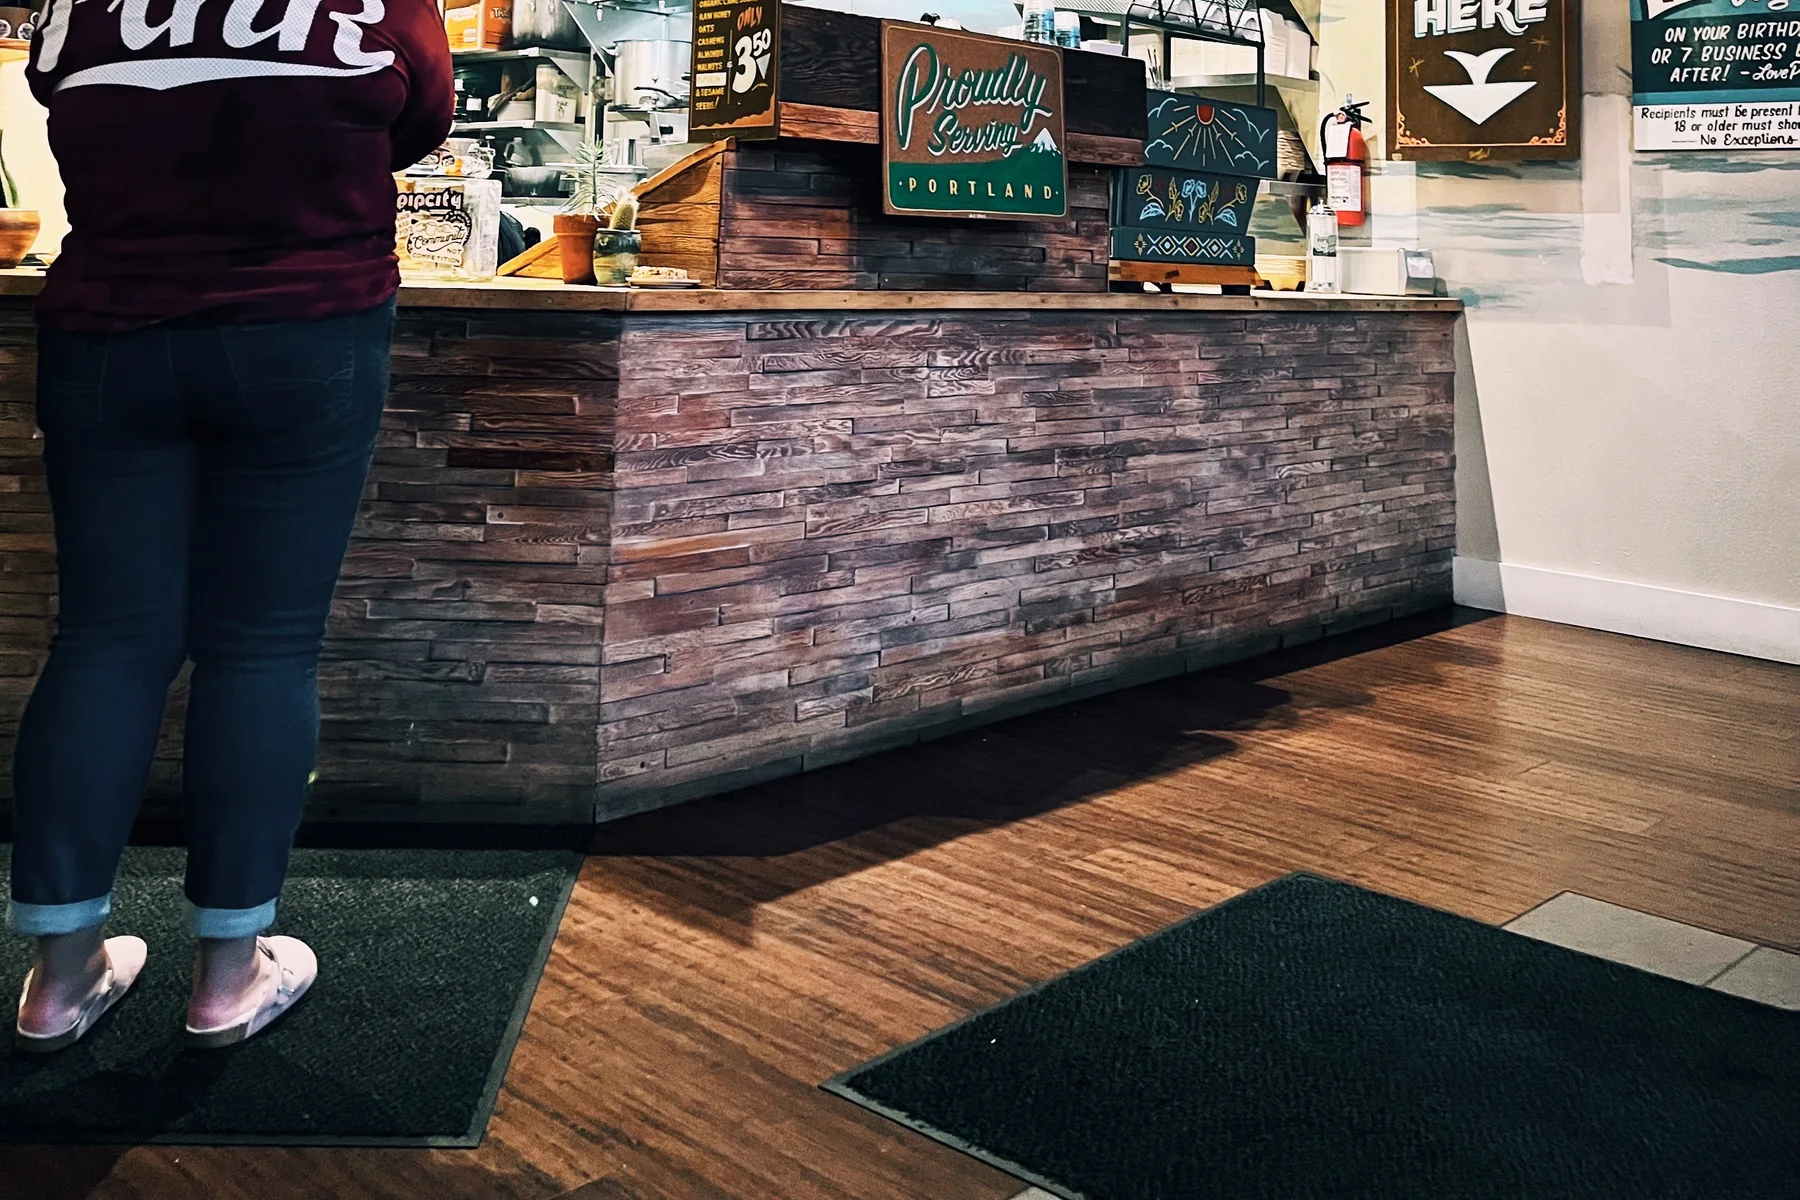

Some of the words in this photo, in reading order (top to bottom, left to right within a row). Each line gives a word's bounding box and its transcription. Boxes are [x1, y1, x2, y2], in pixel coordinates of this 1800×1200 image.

[699, 12, 712, 21] RAW
[737, 6, 763, 31] ONLY
[698, 24, 714, 33] OATS
[1665, 27, 1686, 43] ON
[1693, 25, 1731, 41] YOUR
[1737, 20, 1800, 39] BIRTHD
[697, 36, 725, 46] CASHEWS
[1651, 48, 1672, 65] OR
[1680, 47, 1693, 63] 7
[1701, 43, 1787, 62] BUSINESS
[1670, 64, 1730, 83] AFTER!
[701, 87, 725, 96] SESAME
[896, 43, 1052, 150] Proudly
[1641, 107, 1696, 121] Recipients
[1701, 106, 1729, 118] must
[1734, 105, 1748, 118] be
[1751, 104, 1793, 120] present
[928, 110, 1022, 157] Serving
[1674, 120, 1686, 132] 18
[1691, 122, 1703, 132] or
[1707, 120, 1738, 132] older
[1742, 120, 1771, 131] must
[1700, 135, 1717, 146] No
[1724, 132, 1794, 147] Exceptions
[909, 177, 1052, 199] PORTLAND
[413, 252, 460, 264] COMPETITION
